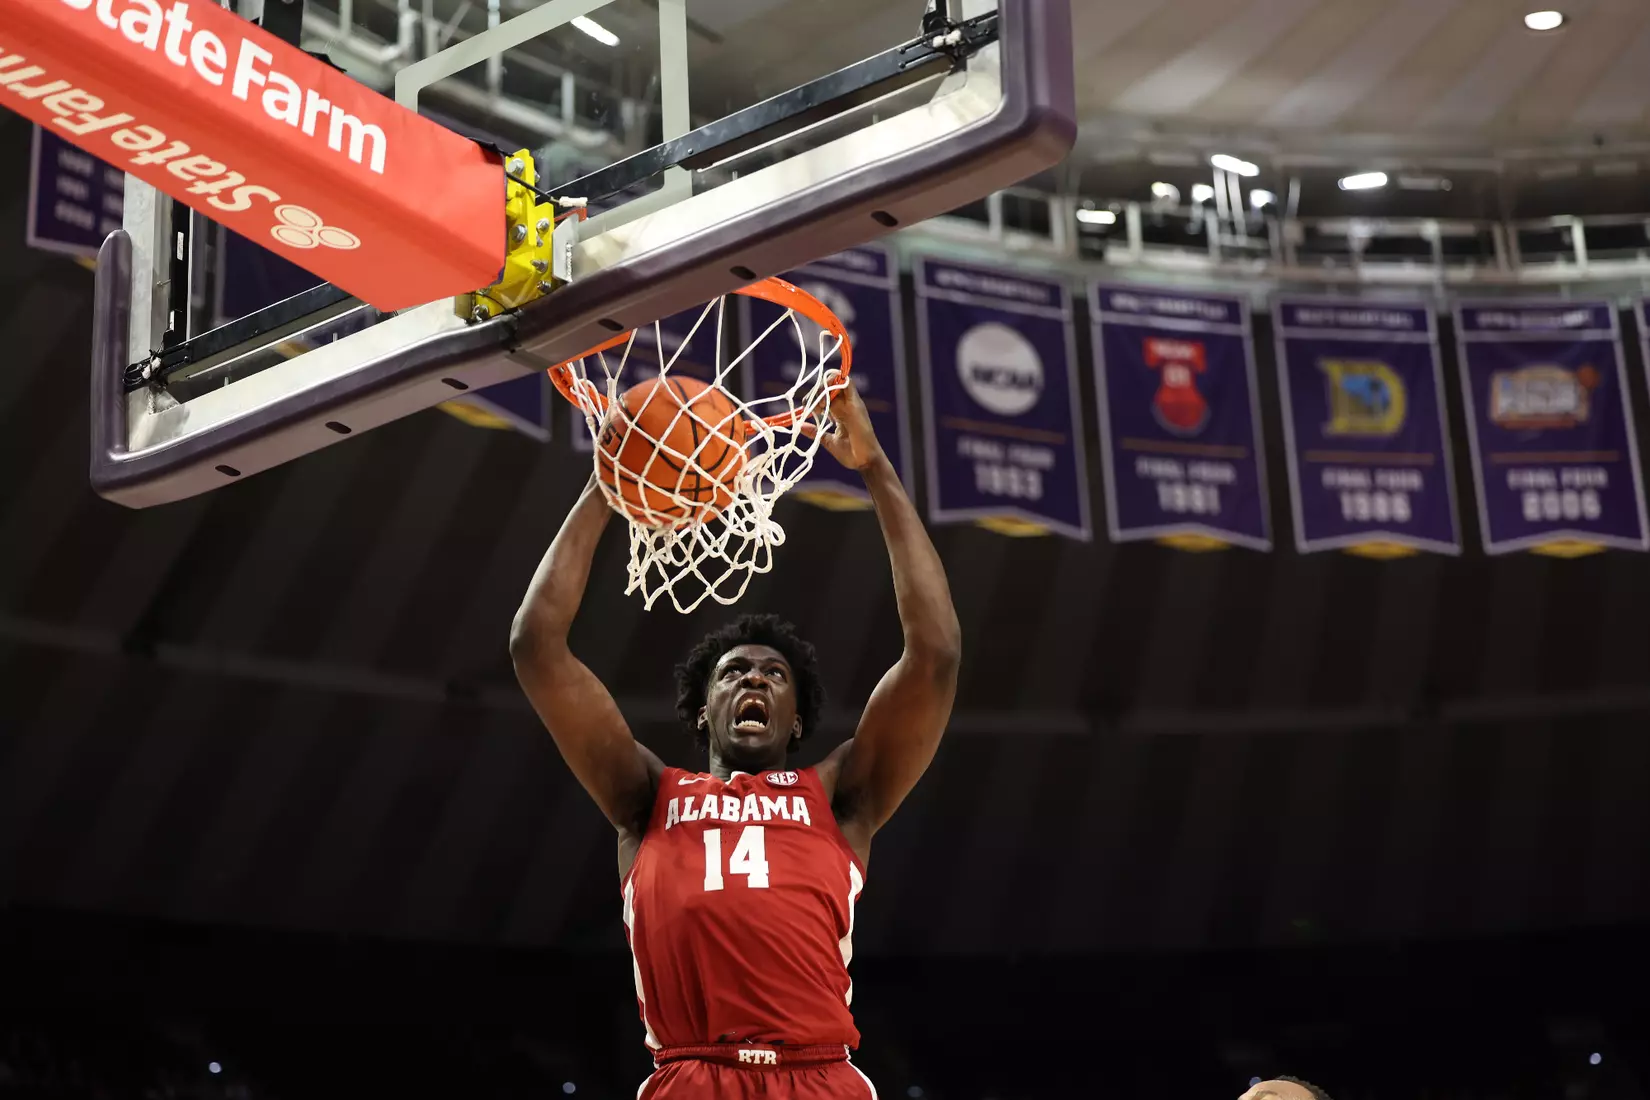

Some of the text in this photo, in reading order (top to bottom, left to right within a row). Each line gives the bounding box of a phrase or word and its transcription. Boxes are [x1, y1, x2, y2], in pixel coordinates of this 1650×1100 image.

[969, 363, 1039, 392] NCAA
[767, 771, 798, 785] SEC
[665, 793, 811, 831] ALABAMA
[703, 825, 770, 892] 14
[738, 1049, 777, 1065] RTR
